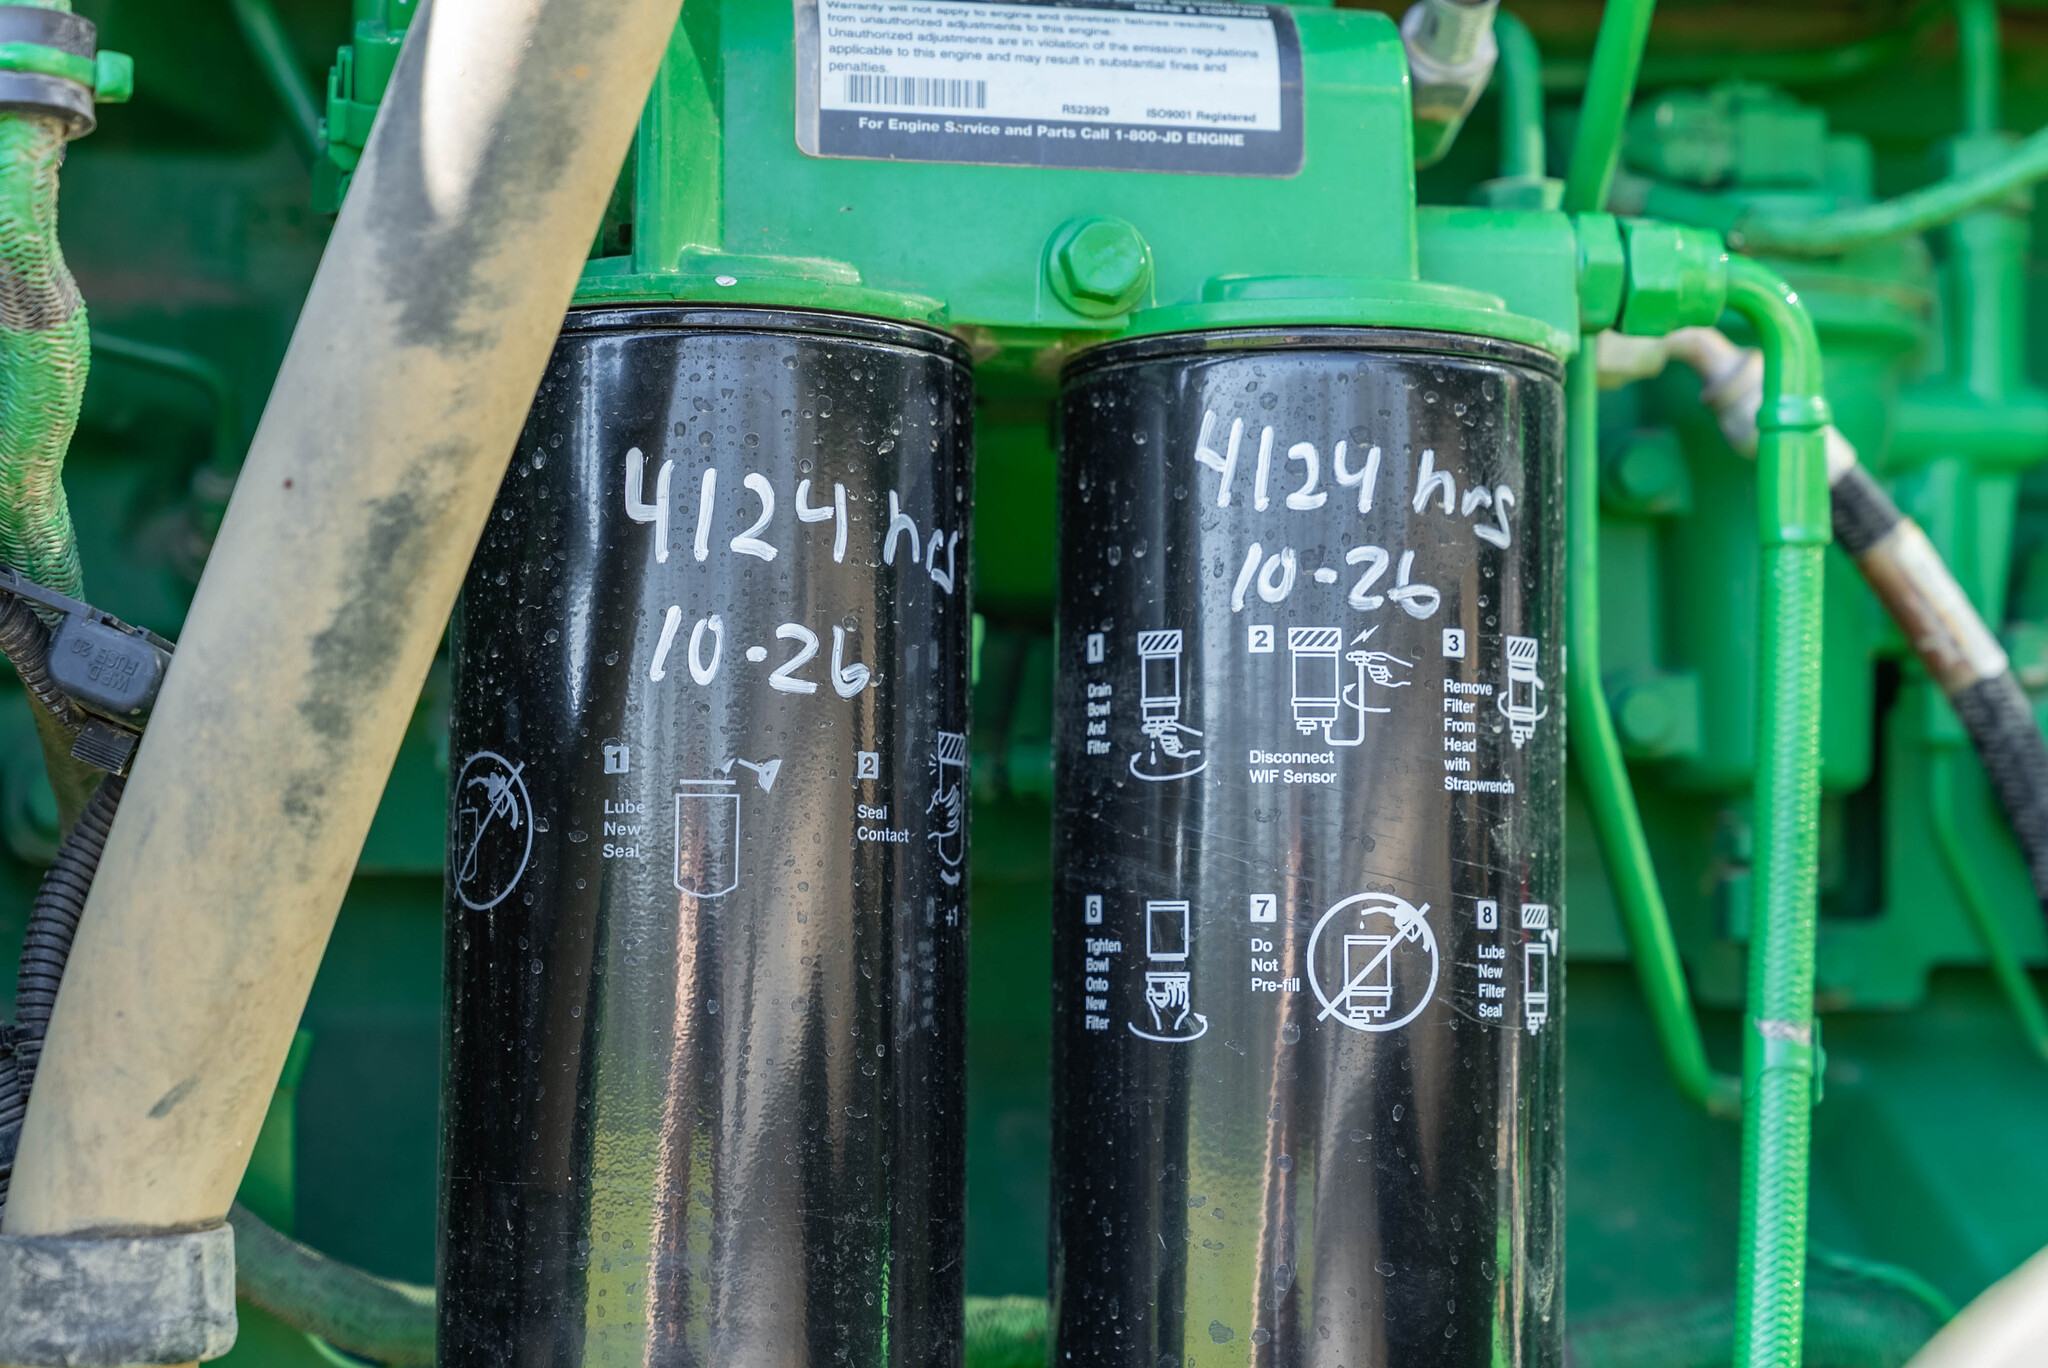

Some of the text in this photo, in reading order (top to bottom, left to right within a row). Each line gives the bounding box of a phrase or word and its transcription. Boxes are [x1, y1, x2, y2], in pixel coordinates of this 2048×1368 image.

[826, 0, 884, 13] Warranty
[889, 3, 908, 12] will
[912, 5, 932, 13] not
[937, 6, 970, 17] apply
[973, 9, 986, 17] to
[990, 10, 1032, 20] engine
[1036, 12, 1060, 21] and
[1125, 17, 1169, 27] failures
[1174, 20, 1226, 31] resulting
[827, 13, 1113, 37] from unauthorized adjustments to this engine.
[828, 28, 1259, 59] Unauthorized adjustments are in violation of the emission regulations
[829, 43, 1227, 72] applicable to this engine and may result in substantial fines and
[829, 61, 889, 74] penalties.
[1146, 108, 1257, 123] ISO9001 Registered
[858, 116, 1245, 147] For Engine Service and Parts Call 1-800-JD ENGINE
[1194, 408, 1515, 550] 4124 hrs
[624, 447, 959, 594] 4124 hrs
[1231, 542, 1441, 620] 10-26
[650, 604, 870, 698] 10-26
[96, 648, 139, 676] FUSE
[1087, 682, 1112, 699] Drain
[1443, 678, 1493, 696] Remove
[1087, 700, 1111, 717] Bowl
[1443, 697, 1476, 714] Filter
[1087, 720, 1107, 737] And
[1444, 718, 1476, 733] From
[1087, 739, 1111, 755] Filter
[1444, 737, 1477, 753] Head
[1249, 750, 1335, 764] Disconnect
[1444, 757, 1471, 772] with
[1249, 769, 1337, 784] WIF Sensor
[1444, 776, 1515, 795] Strapwrench
[604, 798, 646, 815] Lube
[857, 804, 888, 820] Seal
[603, 821, 642, 837] New
[857, 826, 910, 844] Contact
[602, 843, 640, 859] Seal
[1085, 938, 1122, 957] Tighten
[1251, 938, 1273, 953] Do
[1478, 943, 1506, 960] Lube
[1085, 957, 1110, 973] Bowl
[1251, 957, 1279, 973] Not
[1478, 963, 1504, 979] New
[1085, 976, 1109, 992] Onto
[1251, 977, 1301, 993] Pre-fill
[1478, 983, 1507, 999] Filter
[1085, 995, 1108, 1011] New
[1478, 1002, 1503, 1018] Seal
[1085, 1014, 1110, 1030] Filter
